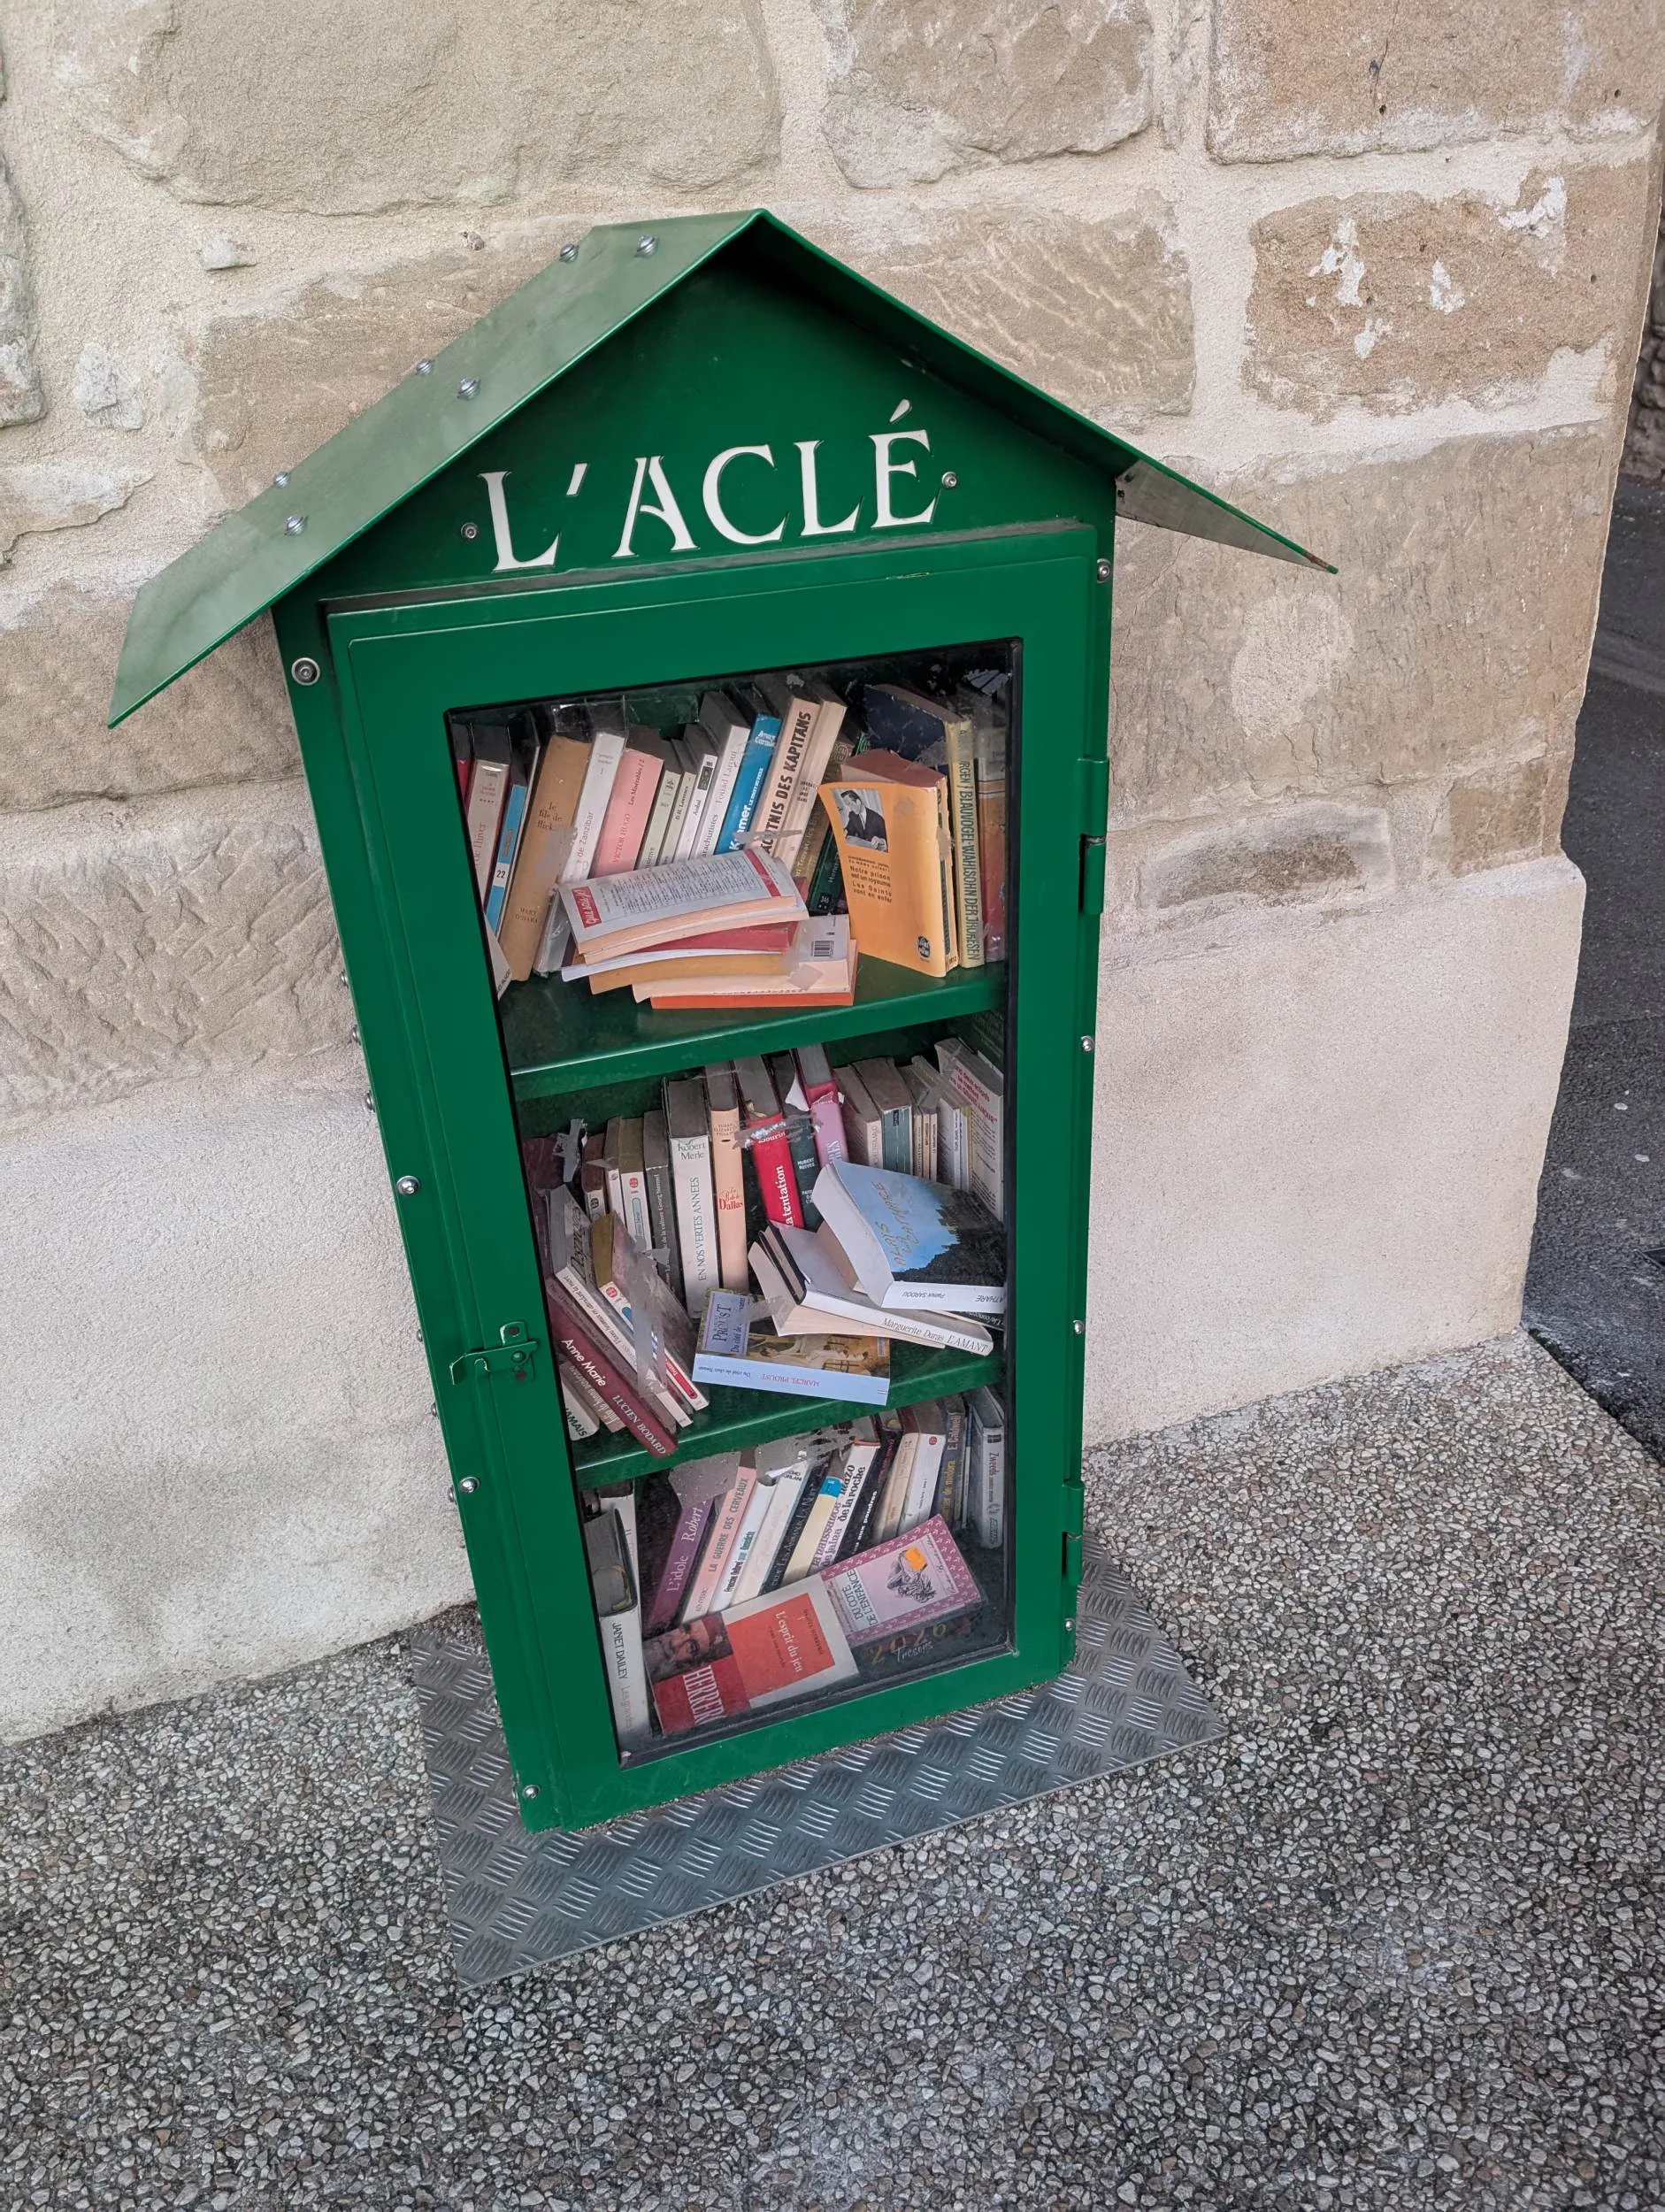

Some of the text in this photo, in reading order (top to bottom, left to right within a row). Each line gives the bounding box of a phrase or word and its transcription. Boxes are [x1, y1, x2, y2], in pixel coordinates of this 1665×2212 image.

[477, 399, 940, 572] L'ACLÉ
[775, 775, 793, 799] DES
[581, 810, 595, 846] Zanzibar
[620, 812, 631, 835] HUGO
[702, 814, 718, 857] arachutistes
[729, 804, 752, 850] Kmer
[495, 869, 506, 879] 22
[677, 1140, 706, 1152] Robert
[776, 1165, 793, 1214] tentation
[718, 1198, 743, 1210] Dallas
[693, 1210, 704, 1246] VERTES
[695, 1247, 706, 1270] NOS
[697, 1270, 707, 1281] EN
[901, 1289, 928, 1299] SARDOU
[975, 1294, 1005, 1304] ATHARE
[883, 1317, 924, 1337] Marguerite
[923, 1327, 944, 1344] Duras
[561, 1339, 607, 1387] Anne Marie
[760, 1371, 819, 1389] MARCEL PROUST
[565, 1409, 588, 1438] AMAIS
[612, 1394, 667, 1455] LUCIEN BODARD
[987, 1452, 999, 1476] Zweeds
[727, 1476, 749, 1513] CERVEAUX
[838, 1465, 866, 1524] de la roche
[863, 1490, 879, 1525] poudres
[721, 1515, 734, 1531] DES
[664, 1505, 705, 1594] L'idole Robert
[711, 1531, 729, 1560] GUERRE
[707, 1562, 718, 1573] LA
[847, 1569, 873, 1615] L'ENFANCE
[771, 1609, 795, 1645] L'esprit
[852, 1608, 864, 1620] DU
[866, 1613, 879, 1625] DE
[611, 1621, 627, 1679] JANET DAILEY
[786, 1644, 799, 1657] du
[788, 1657, 804, 1673] jeu
